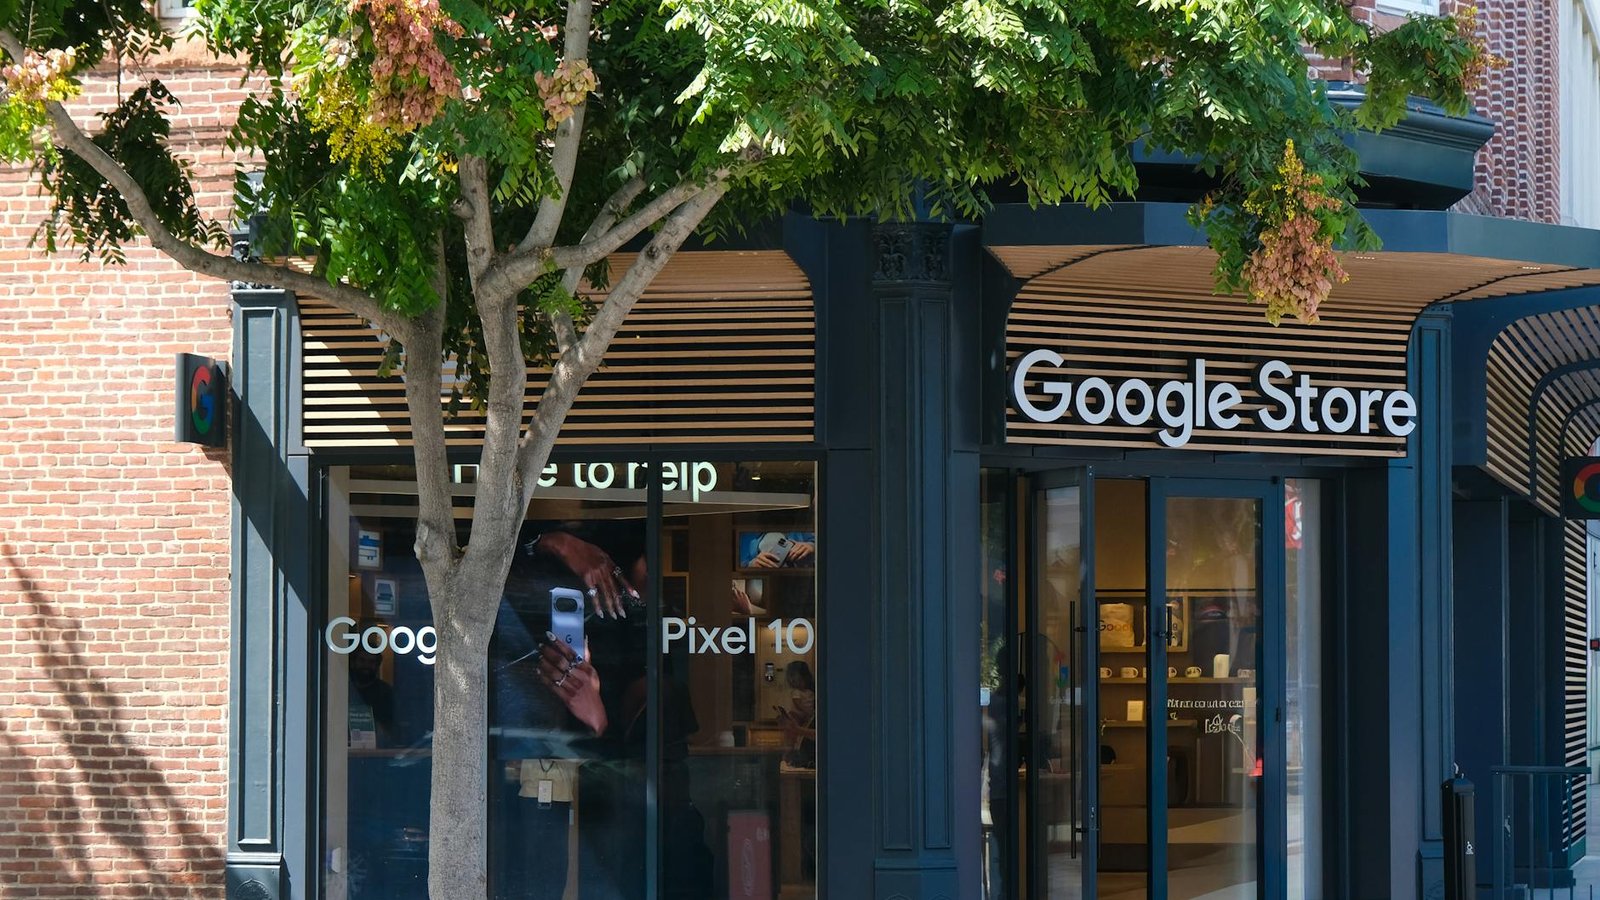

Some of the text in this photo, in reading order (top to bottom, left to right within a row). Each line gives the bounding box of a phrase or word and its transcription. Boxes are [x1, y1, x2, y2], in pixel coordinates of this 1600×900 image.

[191, 365, 214, 435] G
[1014, 349, 1417, 449] Google Store
[573, 462, 615, 490] to
[325, 616, 815, 665] Goog Pixel 10
